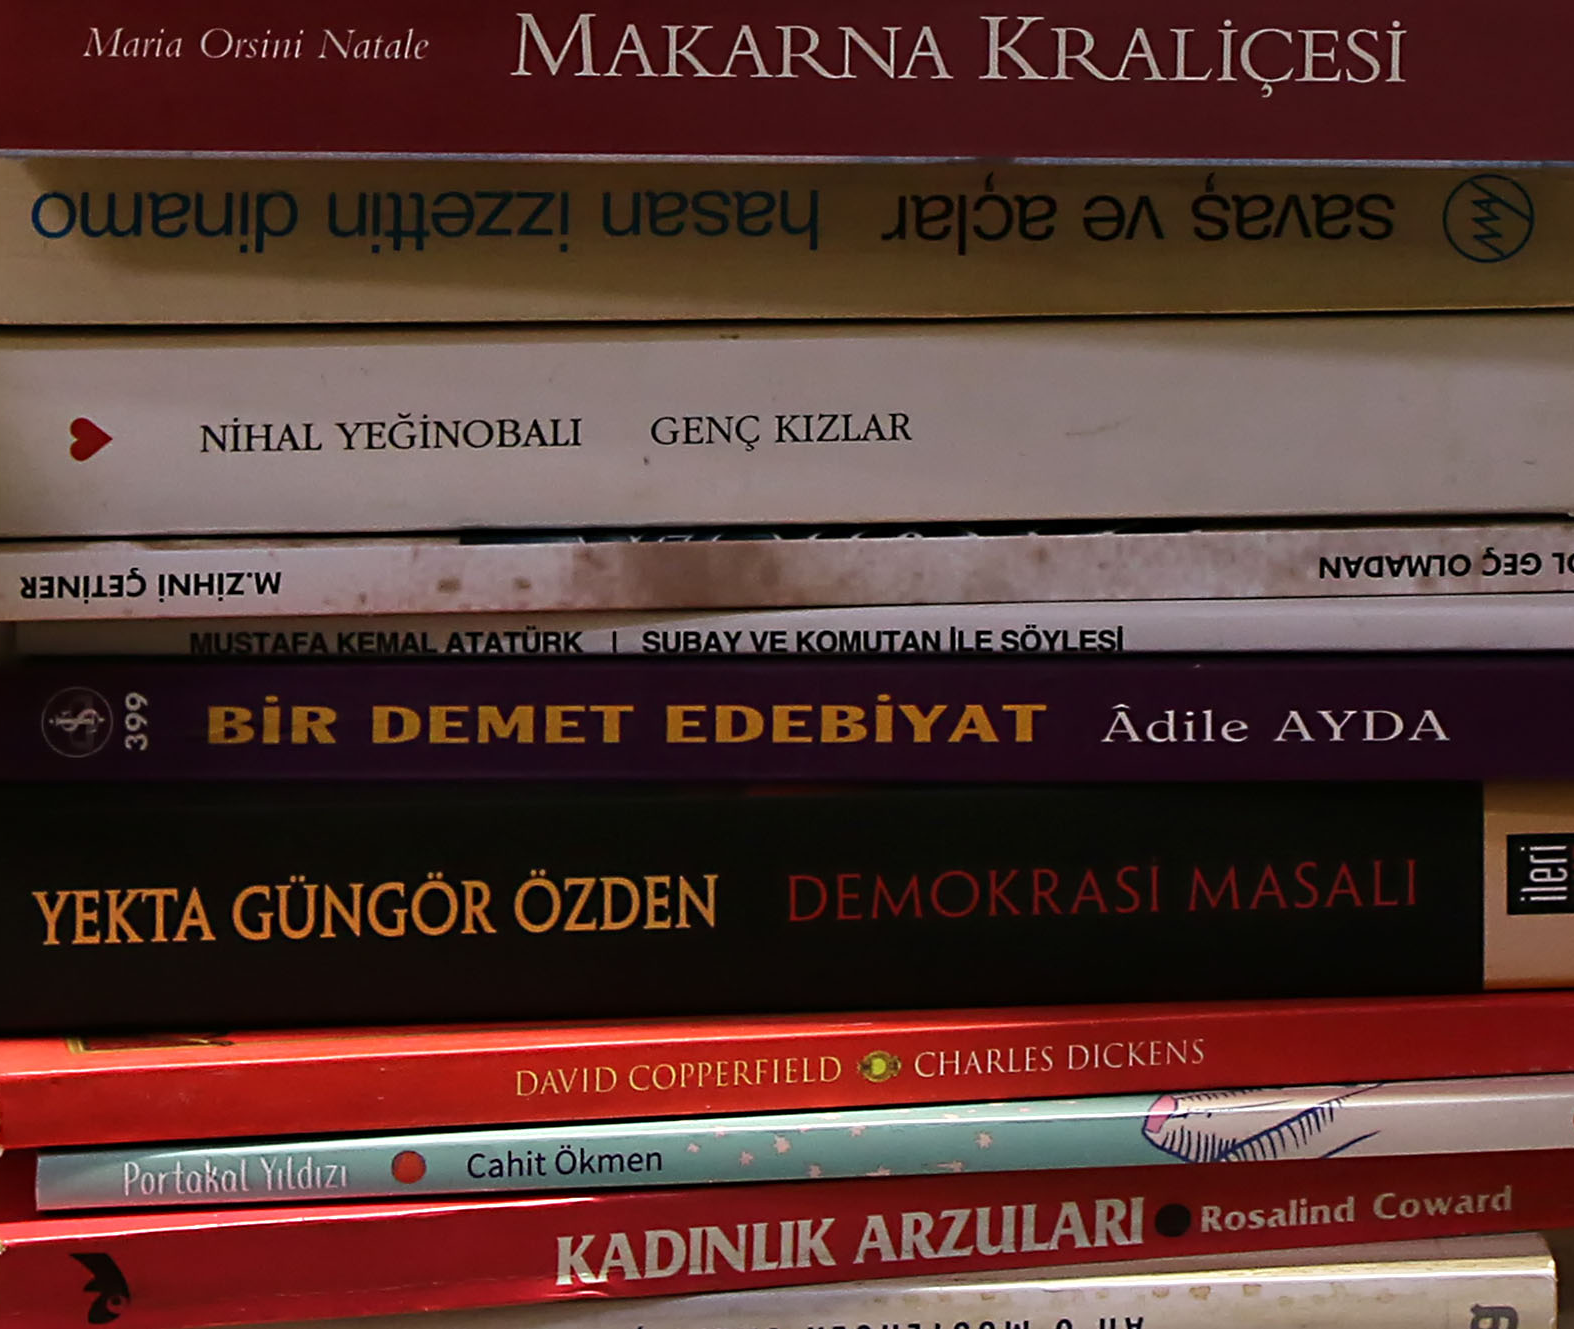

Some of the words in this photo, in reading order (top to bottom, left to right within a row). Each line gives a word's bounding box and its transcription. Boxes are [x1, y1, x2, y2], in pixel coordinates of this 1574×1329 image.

[82, 26, 183, 60] Maria
[199, 27, 304, 60] Orsini
[318, 28, 429, 62] Natale
[30, 190, 299, 254] dinamo
[328, 190, 569, 254] izzettin
[602, 188, 820, 252] hasan
[880, 173, 1056, 256] açlar
[1083, 194, 1164, 241] ve
[1190, 171, 1395, 242] savaş
[199, 416, 322, 454] NİHAL
[335, 412, 581, 452] YEĞİNOBALI
[649, 414, 760, 452] GENÇ
[774, 412, 912, 444] KIZLAR
[1319, 553, 1471, 579] OLMADAN
[1482, 547, 1542, 577] GEÇ
[19, 567, 146, 605] ÇETİNER
[189, 630, 328, 654] MUSTAFA
[337, 629, 437, 654] KEMAL
[448, 625, 583, 654] ATATÜRK
[642, 630, 743, 654] SUBAY
[750, 630, 789, 654] VE
[795, 629, 942, 654] KOMUTAN
[949, 624, 993, 653] İLE
[125, 692, 148, 751] 399
[207, 695, 335, 745] BİR
[370, 704, 633, 745] DEMET
[665, 694, 1047, 744] EDEBİYAT
[1101, 703, 1249, 743] Âdile
[1273, 708, 1450, 742] AYDA
[32, 887, 217, 946] YEKTA
[232, 872, 497, 941] GÜNGÖR
[513, 869, 719, 934] ÖZDEN
[788, 856, 1162, 923] DEMOKRASİ
[1187, 858, 1418, 913] MASALI
[515, 1066, 618, 1097] DAVID
[628, 1055, 842, 1092] COPPERFIELD
[913, 1047, 1054, 1079] CHARLES
[1066, 1038, 1205, 1071] DICKENS
[123, 1158, 251, 1198] Portakal
[260, 1156, 349, 1192] Yıldızı
[466, 1148, 547, 1181] Cahit
[555, 1144, 663, 1176] Ökmen
[1200, 1194, 1356, 1234] Rosalind
[1372, 1185, 1513, 1221] Coward
[555, 1217, 838, 1287] KADINLIK
[853, 1196, 1145, 1265] ARZULARI
